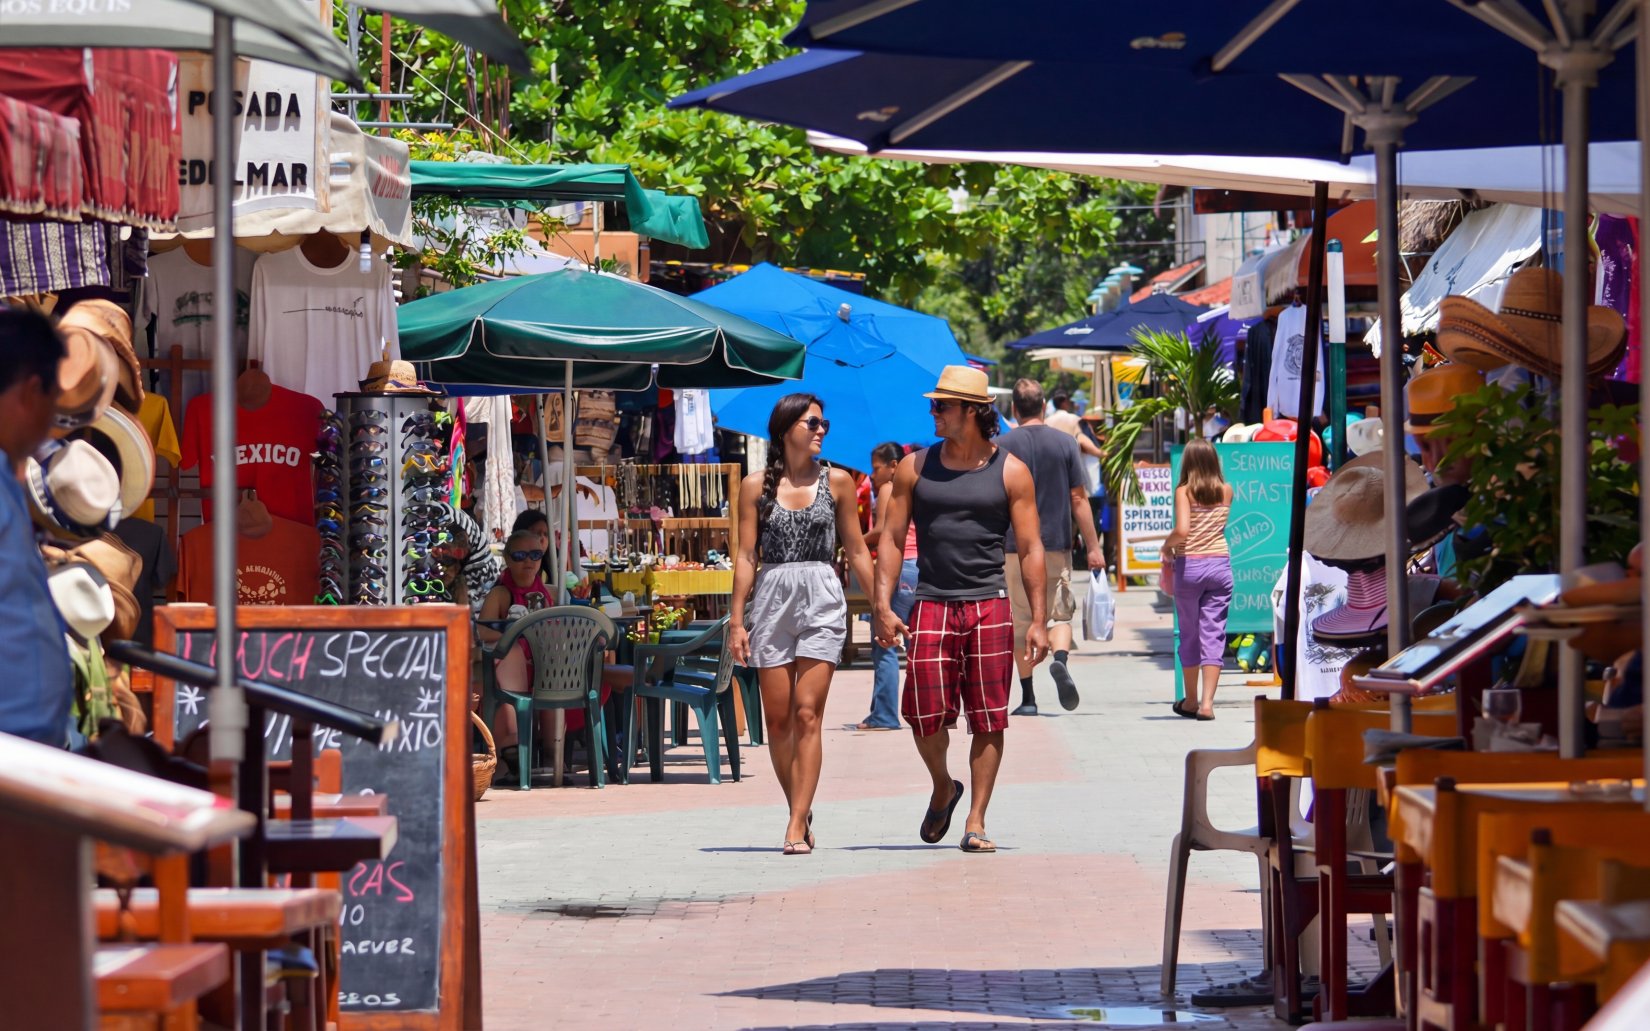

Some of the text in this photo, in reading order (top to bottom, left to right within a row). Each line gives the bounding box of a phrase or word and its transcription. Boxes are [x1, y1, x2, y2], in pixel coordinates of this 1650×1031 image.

[211, 443, 301, 467] EXICO
[1234, 480, 1293, 504] KFAST
[320, 630, 442, 681] SPECIAL
